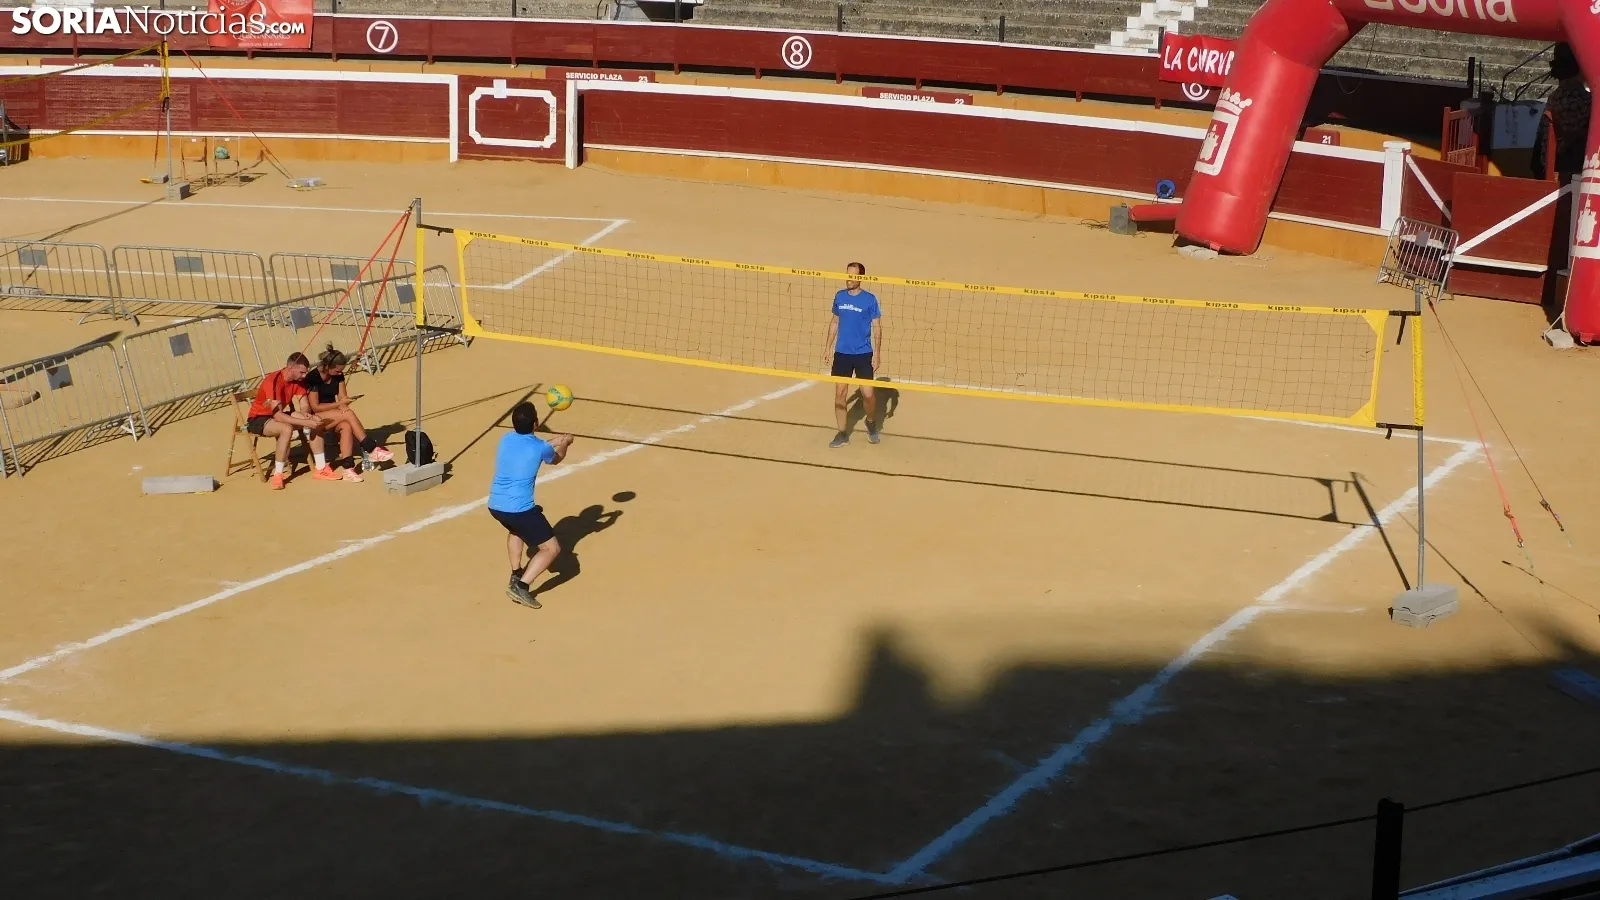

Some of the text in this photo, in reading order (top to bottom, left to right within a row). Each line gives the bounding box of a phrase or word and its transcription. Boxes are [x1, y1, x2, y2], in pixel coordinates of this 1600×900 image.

[375, 26, 389, 48] 7
[790, 41, 803, 65] 8
[1164, 45, 1183, 70] LA
[880, 92, 911, 100] SERVICIO
[1321, 135, 1331, 144] 21
